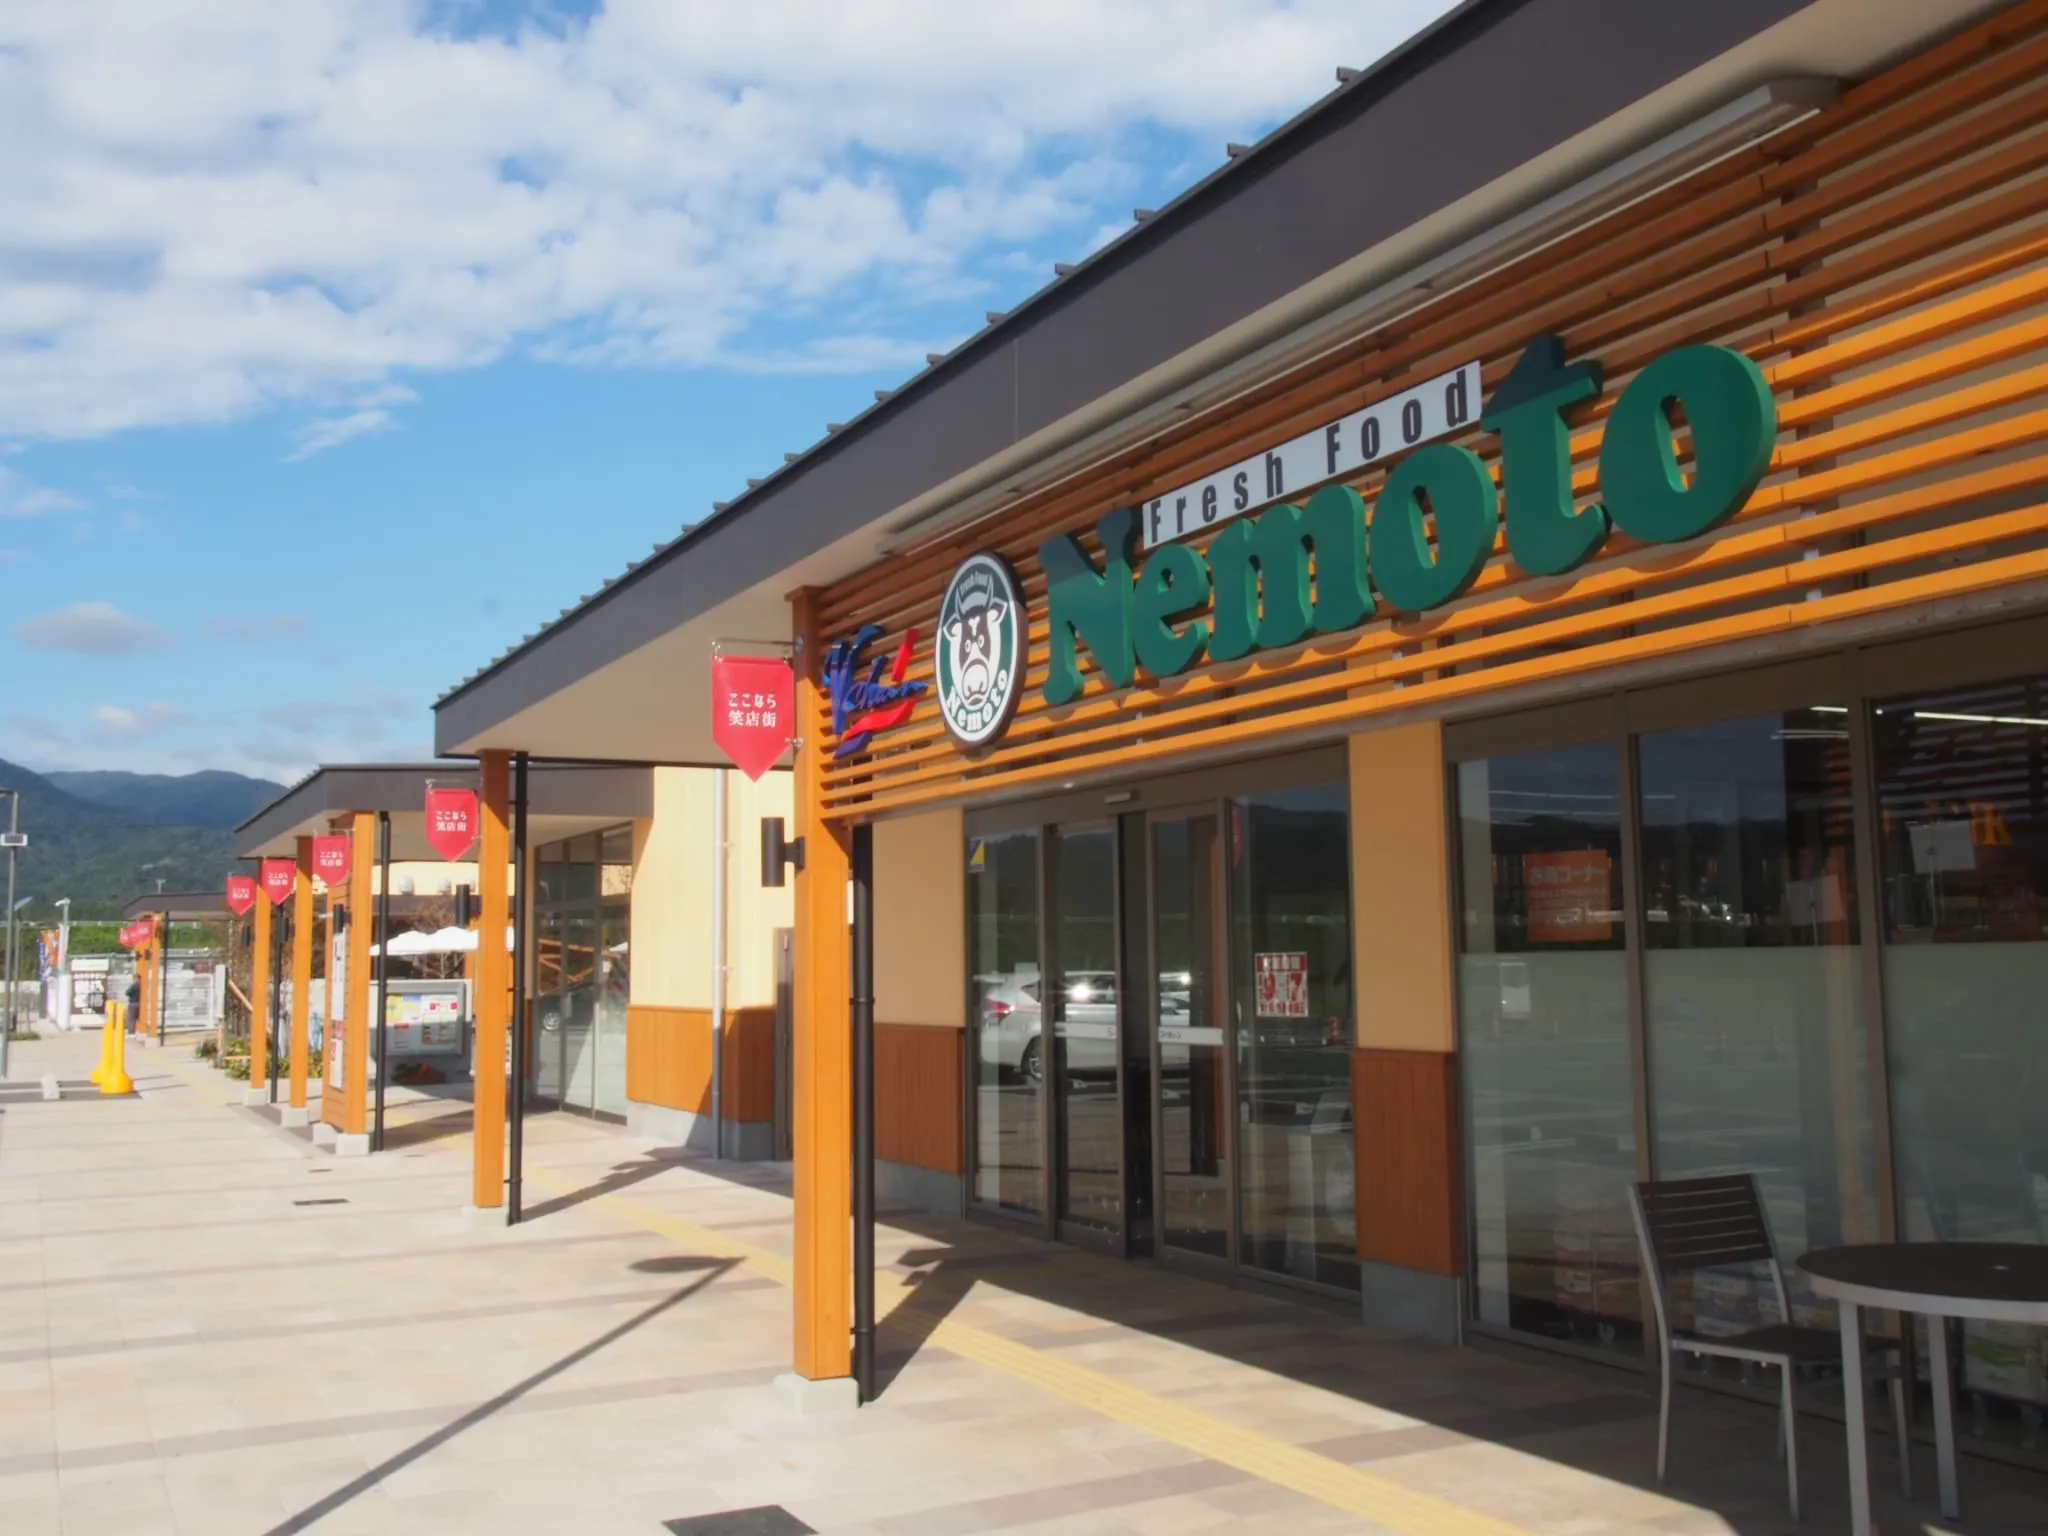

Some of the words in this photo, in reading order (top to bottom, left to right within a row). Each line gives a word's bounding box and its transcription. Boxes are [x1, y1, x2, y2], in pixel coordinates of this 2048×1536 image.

[1150, 451, 1284, 544] Fresh
[1325, 367, 1468, 476] Food
[1038, 334, 1777, 706] Nemoto
[728, 692, 777, 708] ここなら
[728, 709, 777, 728] 笑店街
[946, 669, 1008, 732] Nemoto
